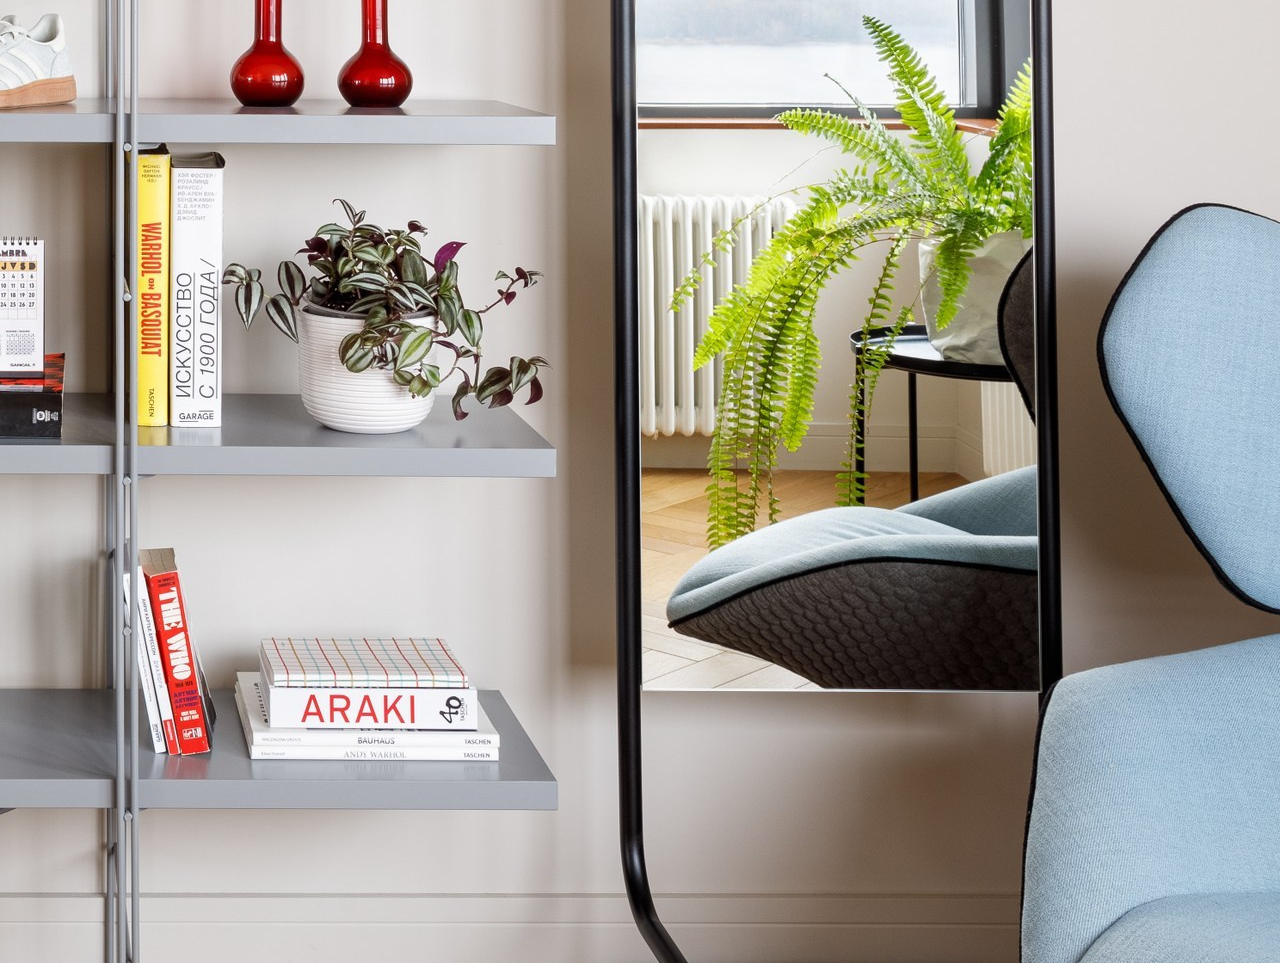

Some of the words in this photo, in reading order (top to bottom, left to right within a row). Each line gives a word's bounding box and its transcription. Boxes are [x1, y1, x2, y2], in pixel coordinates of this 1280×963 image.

[142, 222, 162, 277] WARHOL
[149, 278, 154, 290] ON
[141, 293, 162, 357] BASQUIAT
[176, 272, 191, 398] ИСКУССТВО
[199, 333, 215, 375] 1900
[159, 587, 183, 631] THE
[167, 632, 192, 680] WHO
[301, 694, 415, 724] ARAKI
[439, 696, 461, 724] 40
